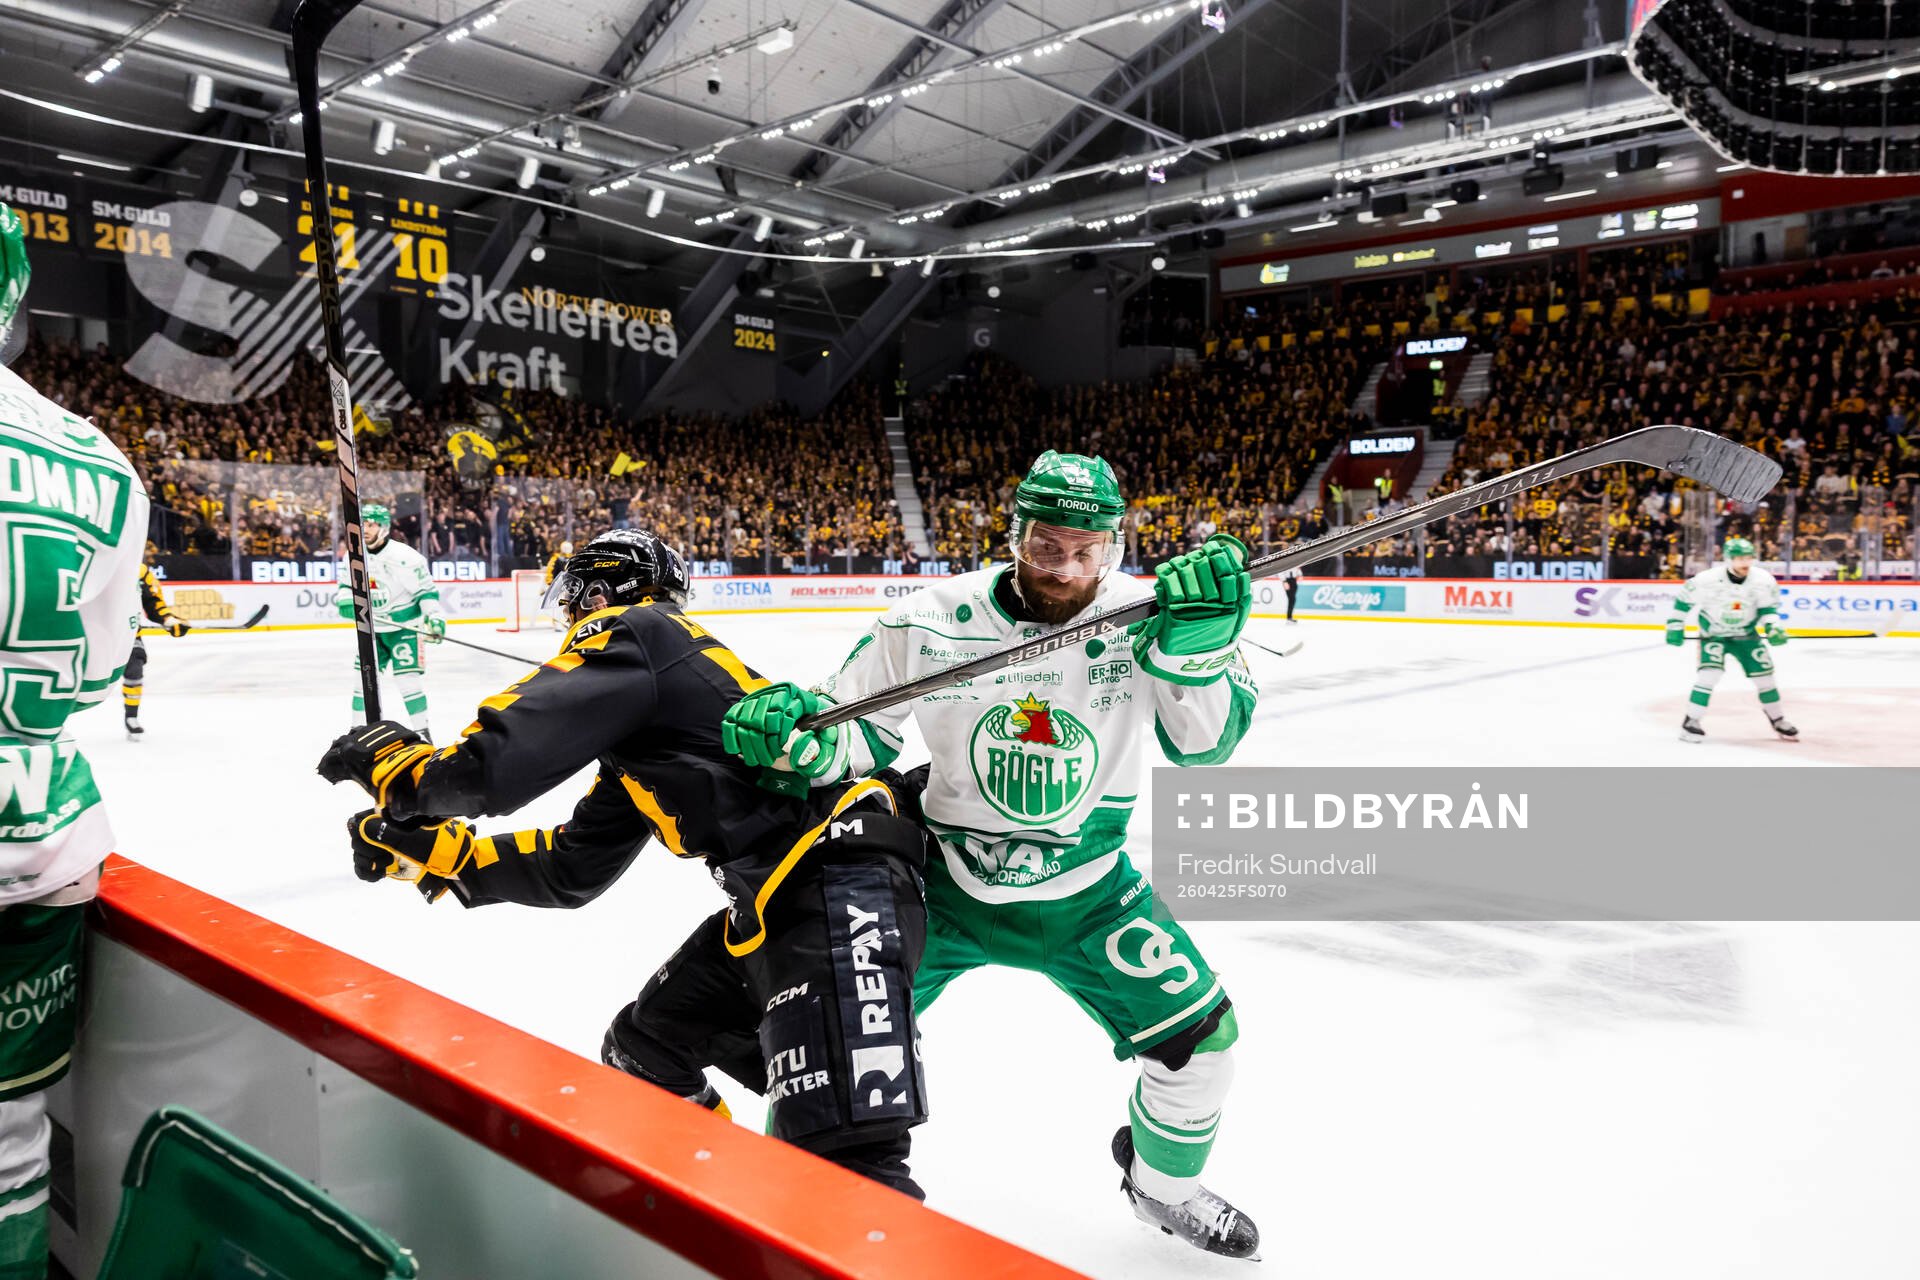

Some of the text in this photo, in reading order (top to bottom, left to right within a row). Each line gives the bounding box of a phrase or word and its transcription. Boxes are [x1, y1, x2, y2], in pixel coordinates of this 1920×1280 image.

[95, 222, 172, 258] 2014
[392, 232, 448, 284] 10
[522, 287, 674, 328] NORTH POWER
[734, 328, 776, 351] 2024
[973, 327, 991, 347] G
[439, 338, 567, 397] Kraft
[338, 408, 347, 430] PRO
[1350, 437, 1415, 454] BOLIDEN
[1460, 467, 1555, 509] FLYLITE
[593, 560, 621, 568] CCM
[346, 522, 372, 636] CCM
[726, 582, 772, 596] STENA
[790, 585, 876, 597] HOLMSTRÖM
[1445, 586, 1513, 608] MAXI
[1007, 624, 1097, 665] BAUER
[1091, 663, 1129, 681] ER-HO
[1100, 676, 1121, 684] BYGG
[1090, 691, 1133, 709] GRAM
[987, 744, 1083, 816] RÖGLE
[846, 904, 893, 1035] REPAY
[766, 982, 809, 1012] CCM
